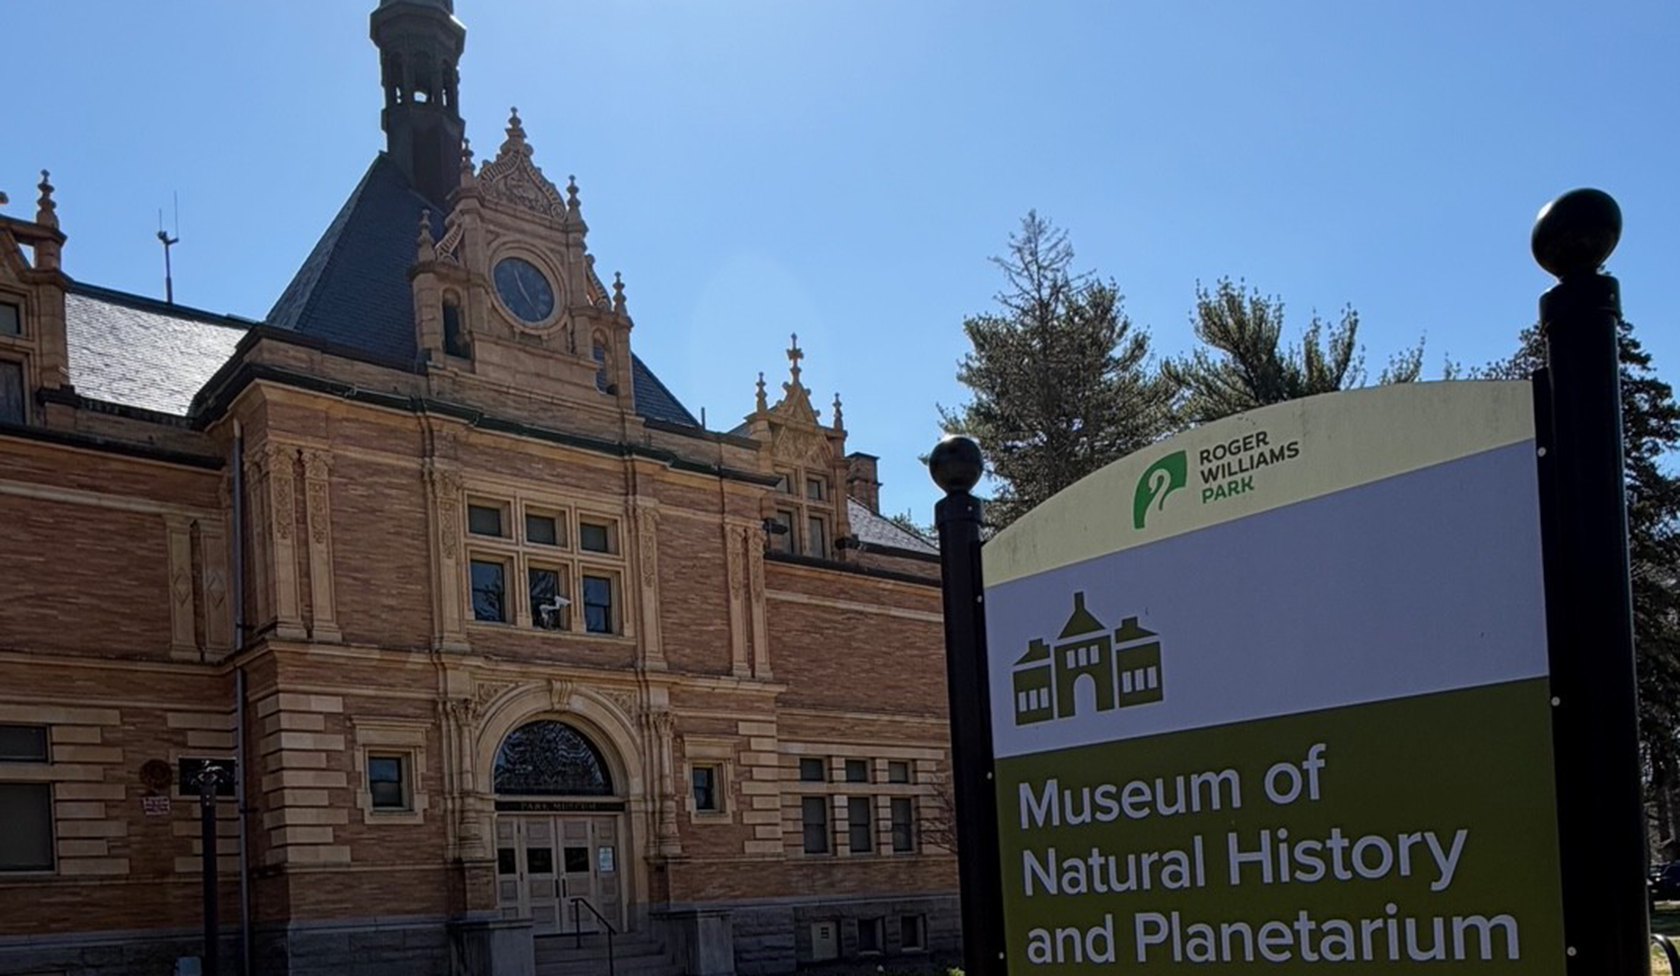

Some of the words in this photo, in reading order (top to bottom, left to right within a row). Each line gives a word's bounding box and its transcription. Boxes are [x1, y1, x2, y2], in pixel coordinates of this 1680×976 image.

[1199, 430, 1270, 466] ROGER
[1200, 440, 1301, 485] WILLIAMS
[1201, 475, 1255, 504] PARK
[1018, 769, 1242, 830] Museum
[1264, 743, 1327, 804] of
[1023, 835, 1206, 896] Natural
[1227, 827, 1468, 891] History
[1027, 913, 1116, 964] and
[1134, 902, 1520, 963] Planetarium
